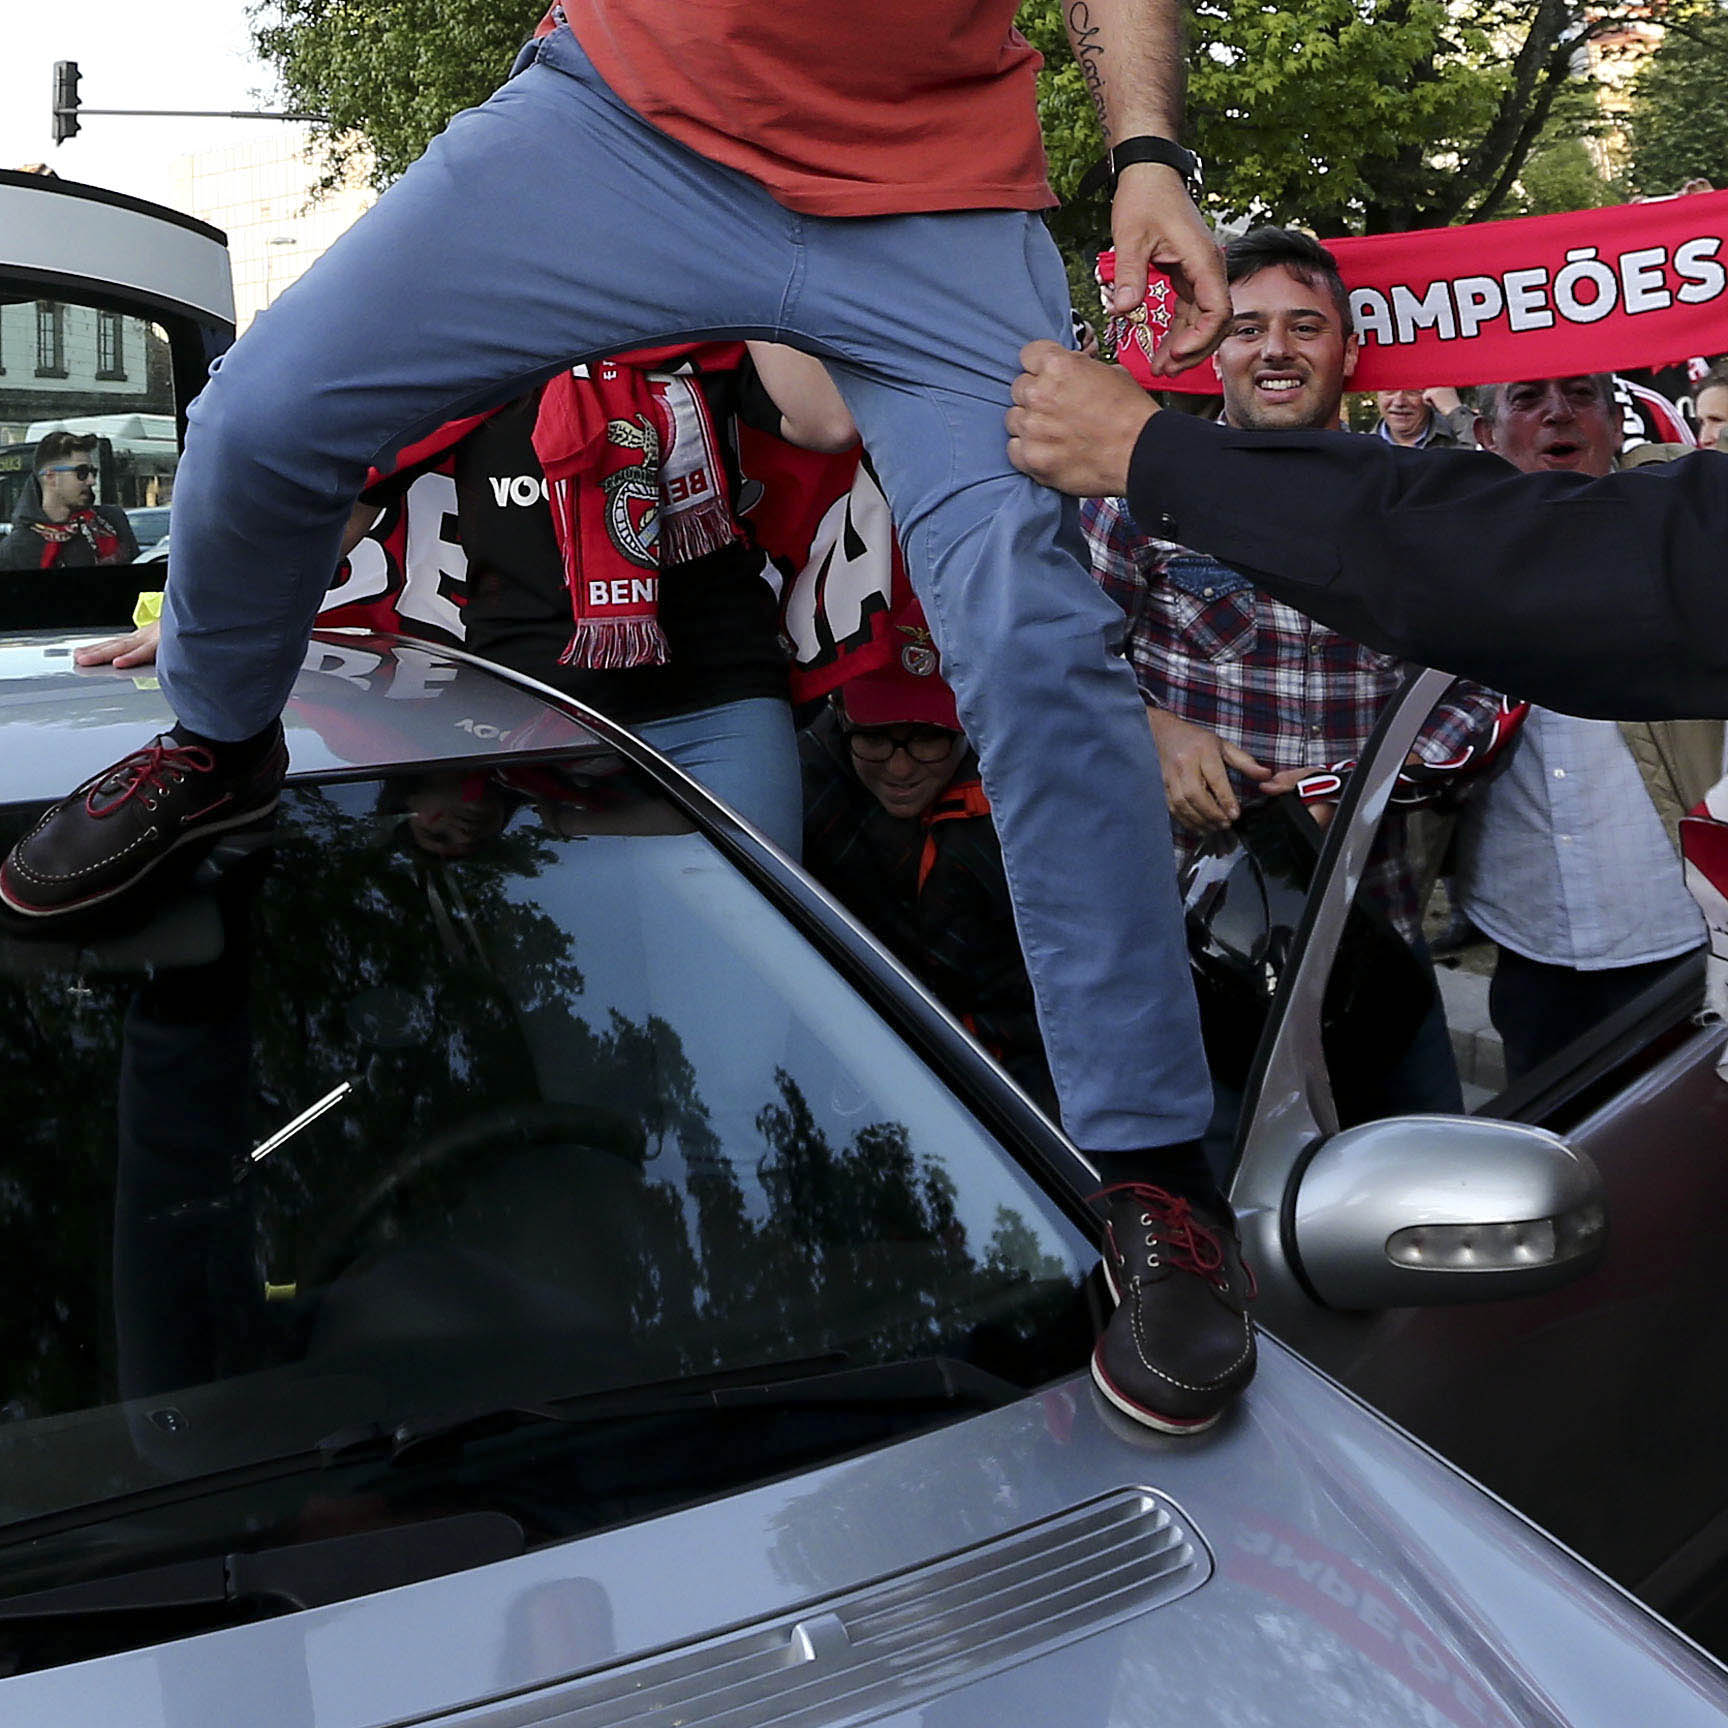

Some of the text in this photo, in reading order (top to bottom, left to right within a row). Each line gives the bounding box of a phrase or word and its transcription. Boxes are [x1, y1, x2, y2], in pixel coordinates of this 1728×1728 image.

[1348, 236, 1727, 346] AMPEÕES
[488, 475, 550, 508] VO
[588, 577, 659, 607] BEN
